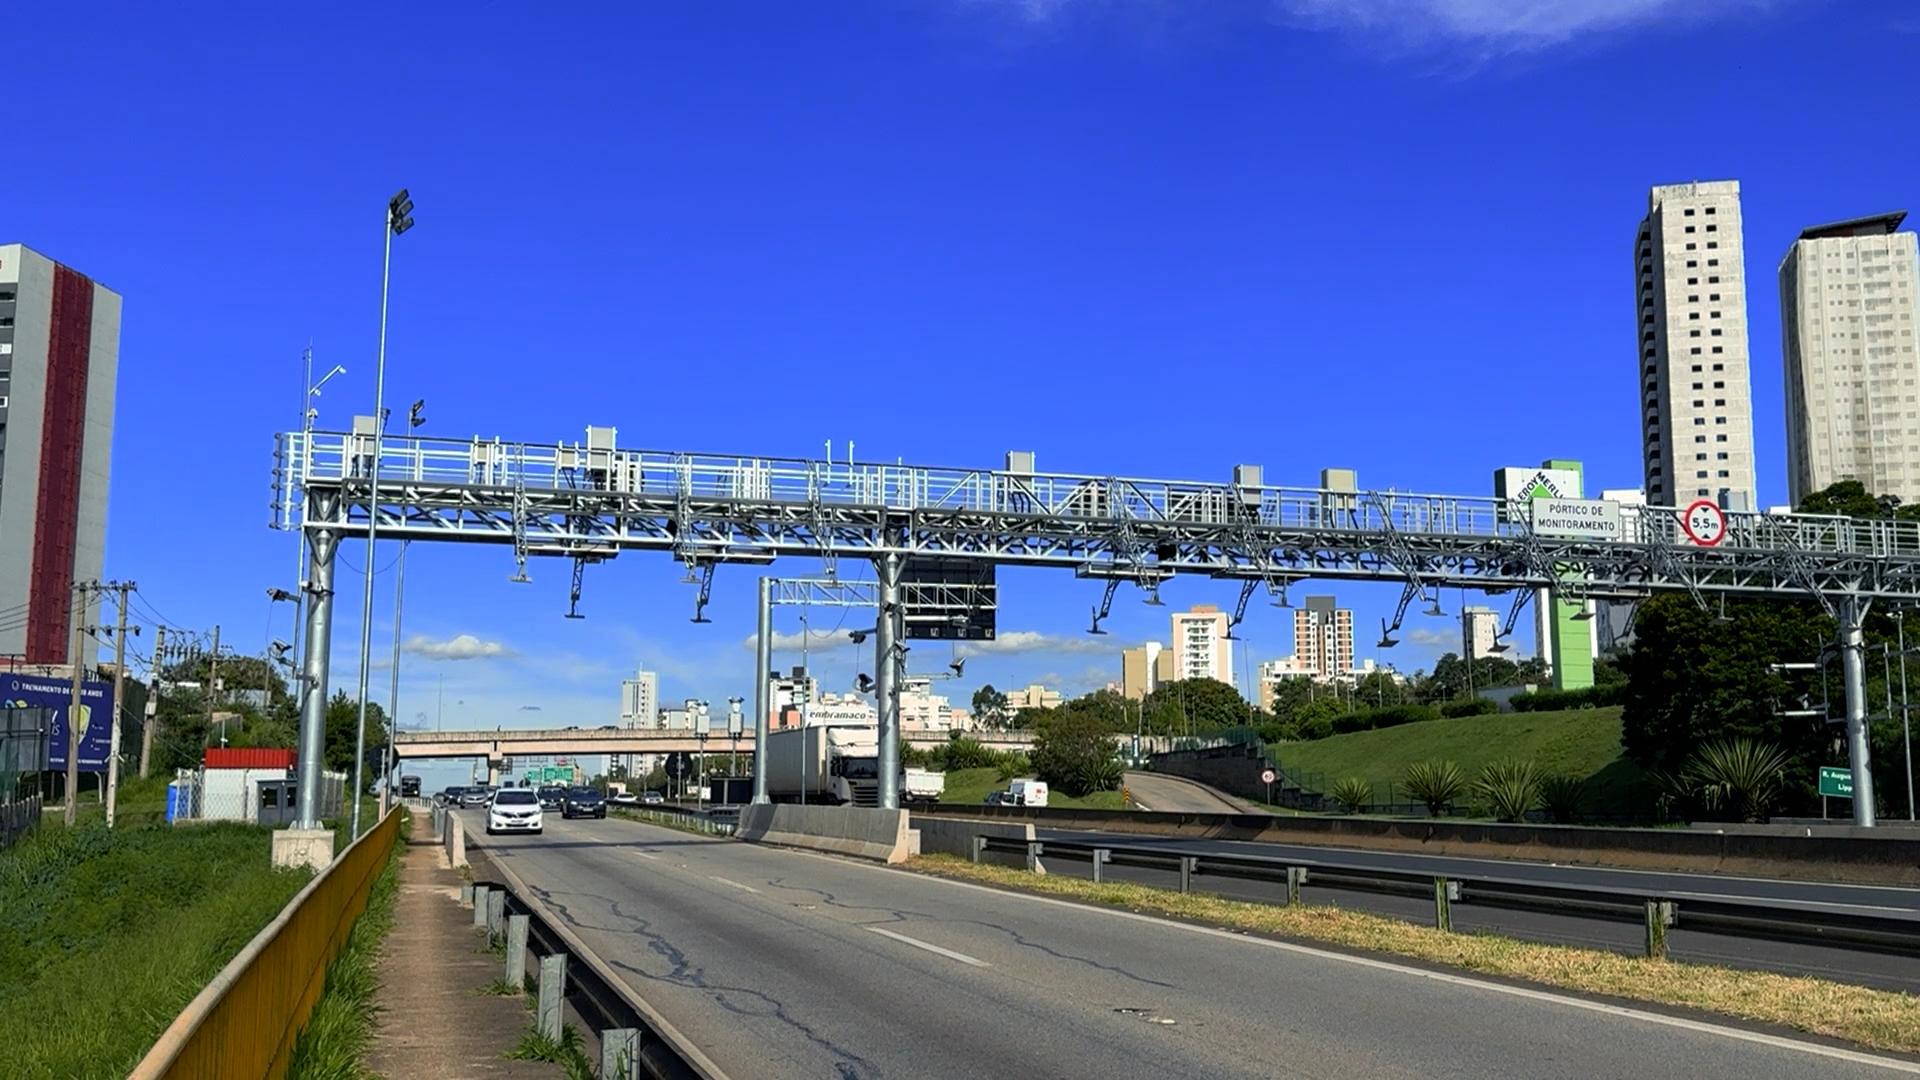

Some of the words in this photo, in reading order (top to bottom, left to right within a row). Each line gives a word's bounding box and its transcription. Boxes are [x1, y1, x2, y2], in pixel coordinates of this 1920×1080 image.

[1549, 501, 1588, 515] PÓRTICO
[1591, 506, 1603, 516] DE
[1538, 519, 1615, 531] MONITORAMENTO
[22, 683, 61, 695] TREINAMENTO
[809, 711, 866, 719] embramaco
